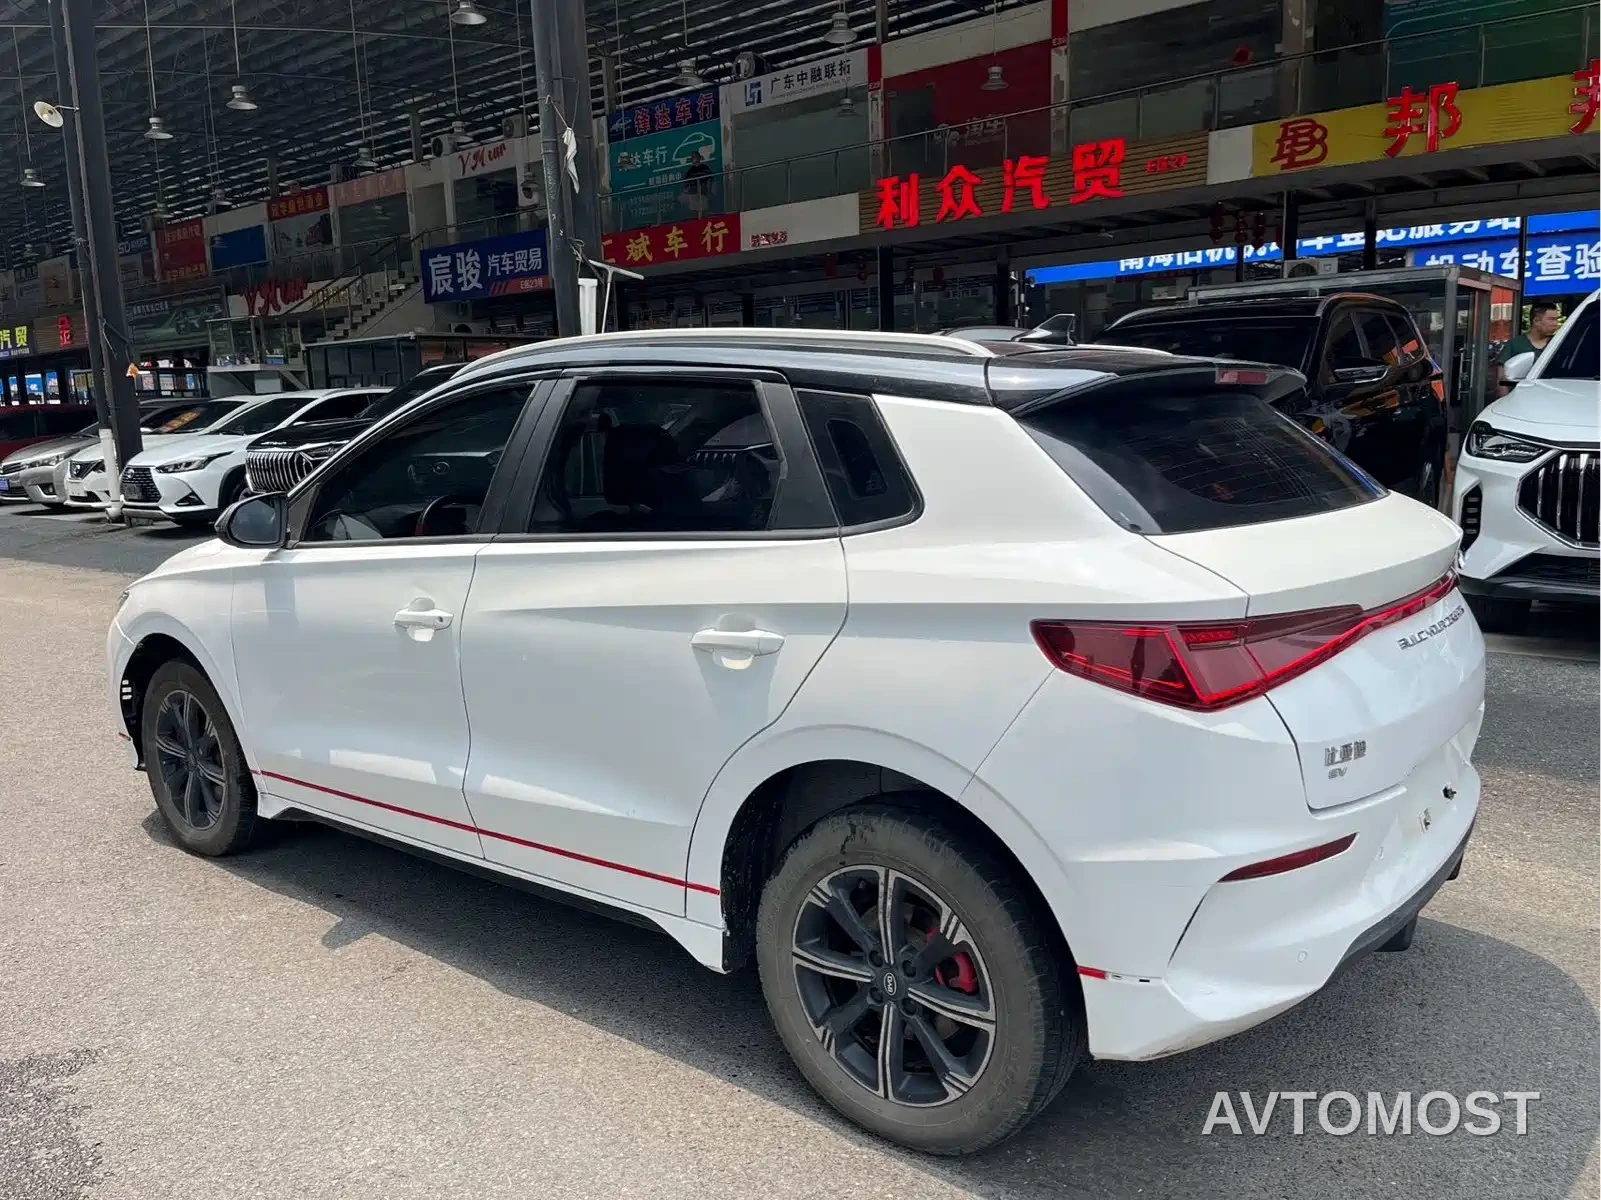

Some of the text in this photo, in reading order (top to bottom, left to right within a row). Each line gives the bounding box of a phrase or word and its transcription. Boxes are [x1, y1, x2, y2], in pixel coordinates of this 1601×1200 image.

[876, 137, 1127, 231] 利众汽贸
[487, 247, 543, 278] 汽车贸易
